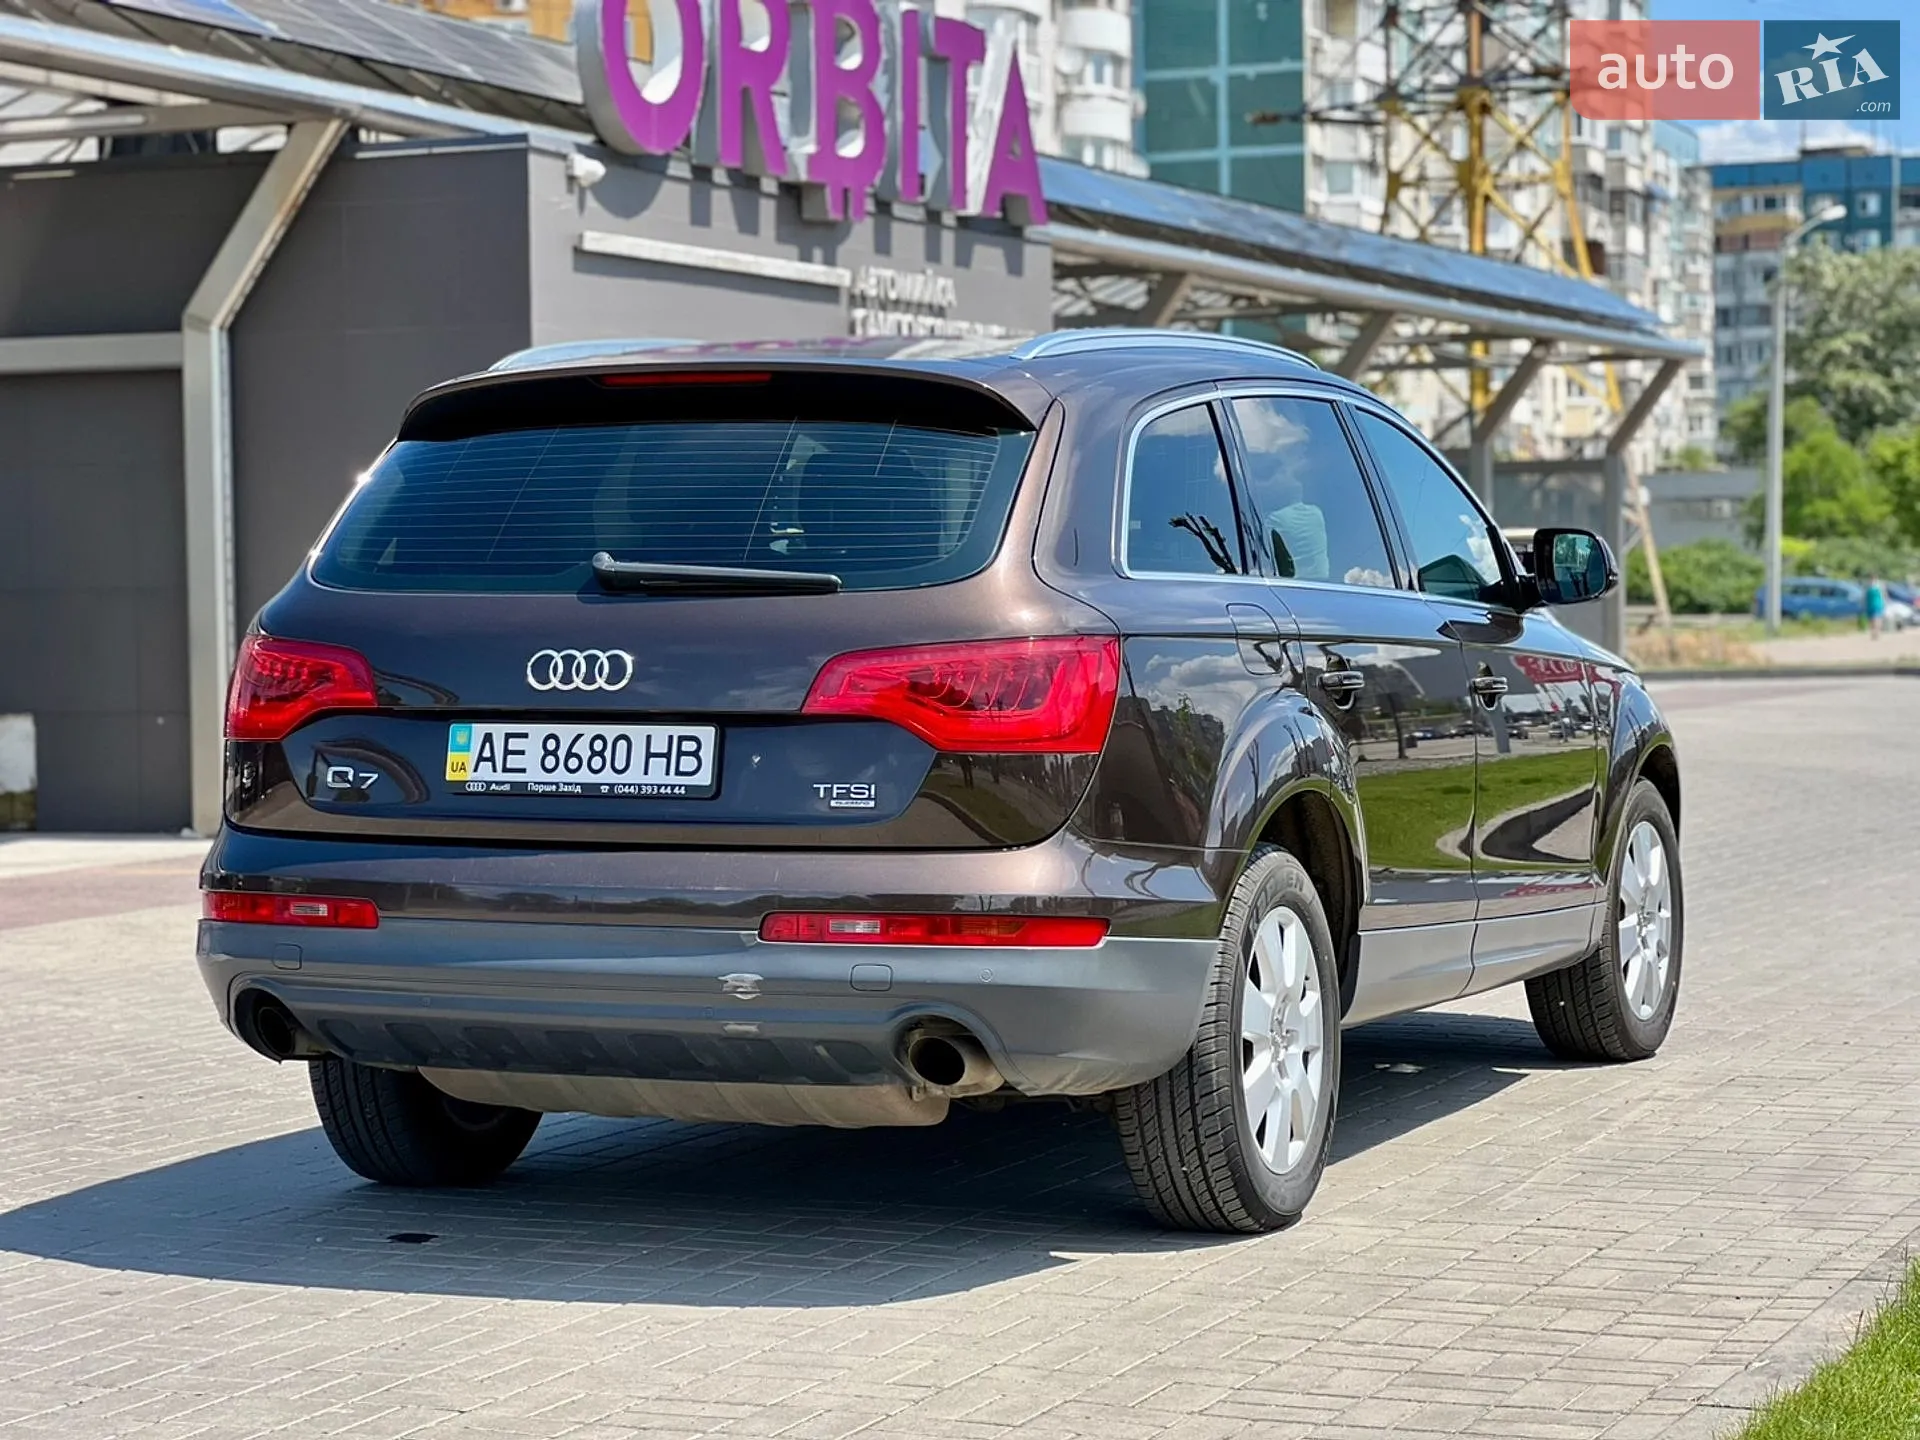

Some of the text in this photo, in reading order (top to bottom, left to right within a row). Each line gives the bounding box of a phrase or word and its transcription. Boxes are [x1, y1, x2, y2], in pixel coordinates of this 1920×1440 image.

[600, 0, 1048, 225] ORBITA
[473, 732, 703, 777] AE 8680 HB
[450, 761, 467, 773] UA
[326, 766, 379, 789] Q7
[489, 783, 511, 791] Audi
[527, 782, 557, 793] Порше
[614, 785, 639, 795] (044)
[640, 786, 658, 795] 393
[813, 783, 876, 799] TFSI
